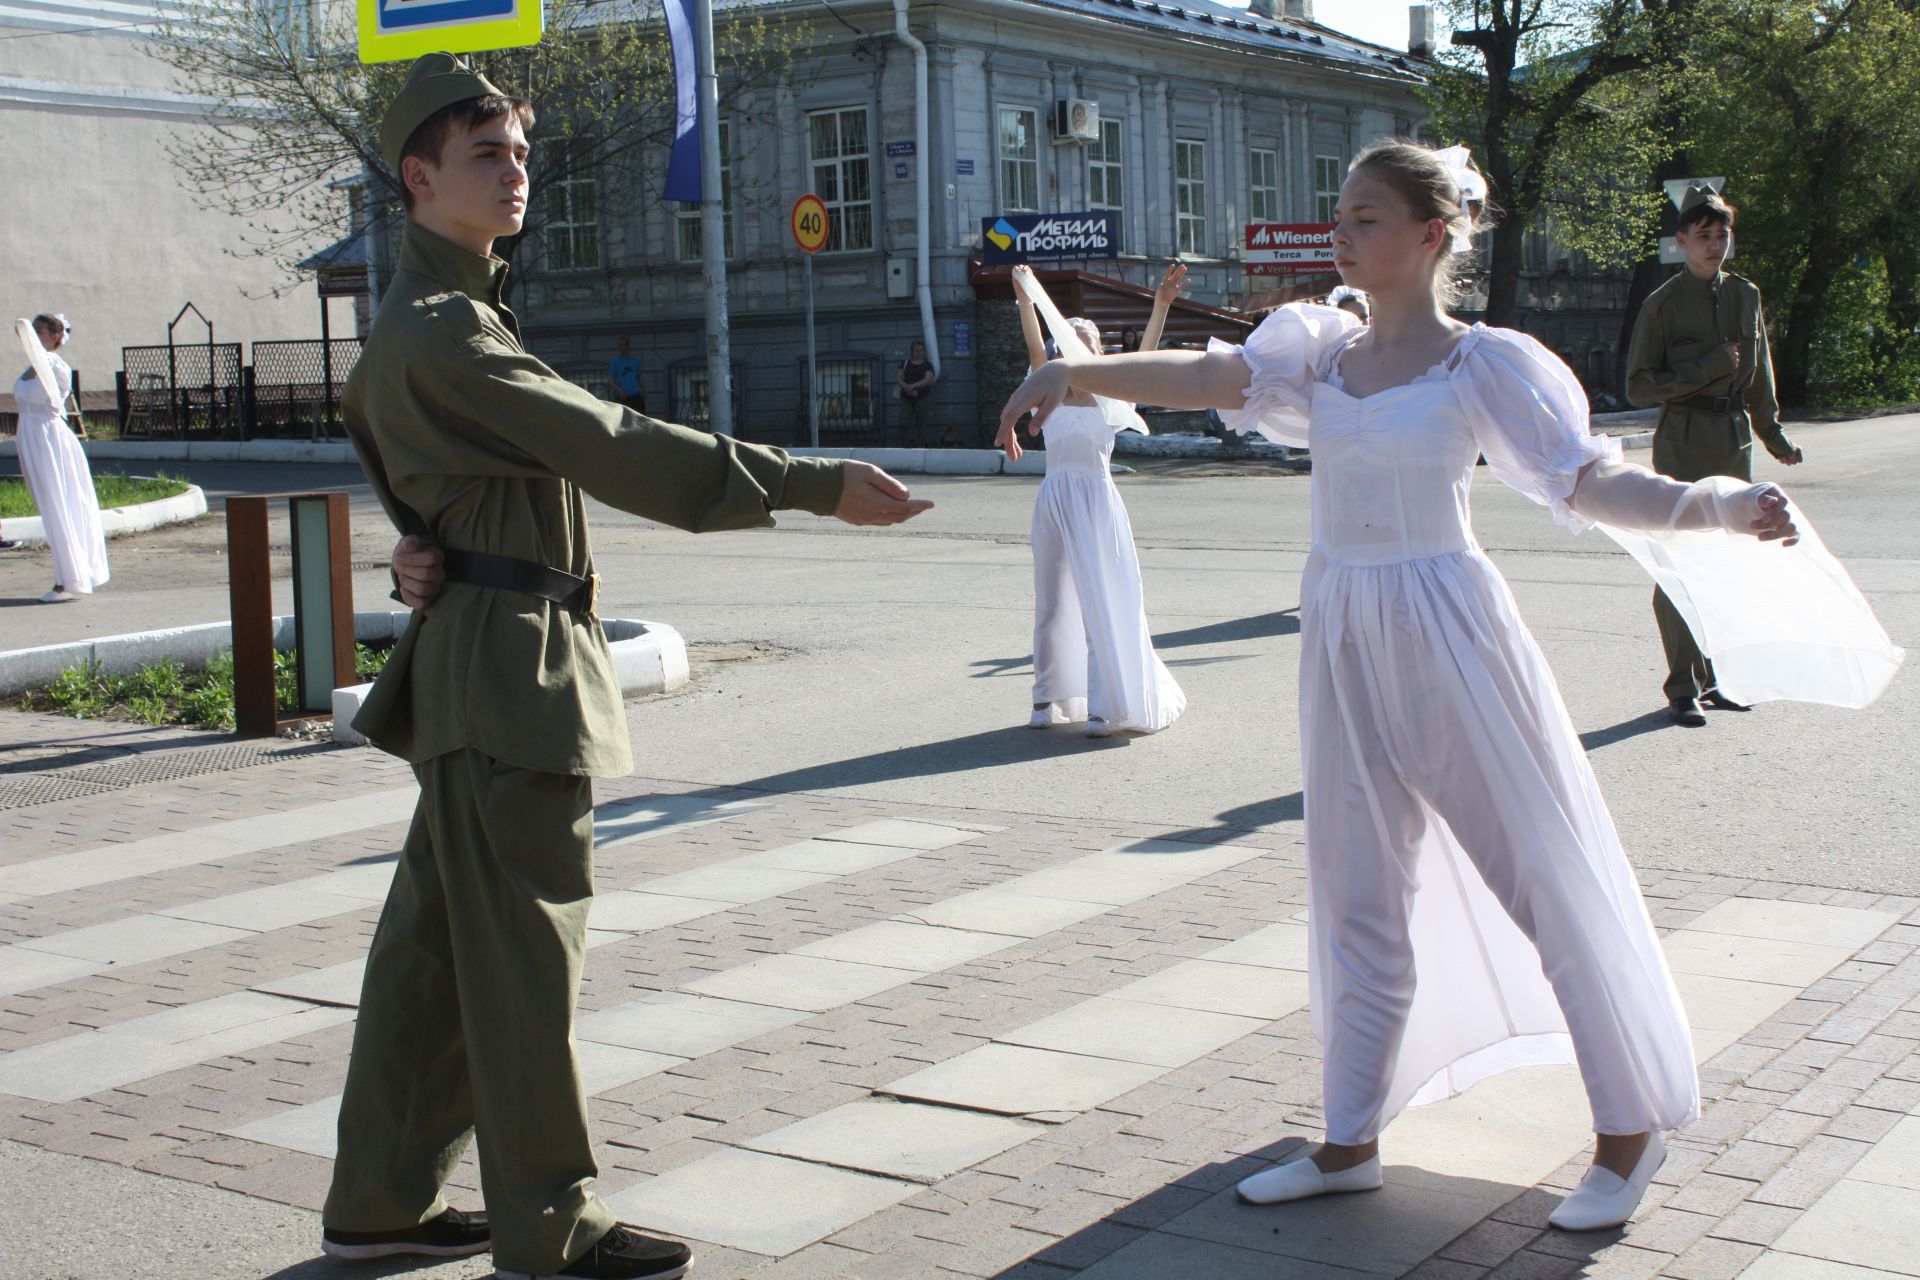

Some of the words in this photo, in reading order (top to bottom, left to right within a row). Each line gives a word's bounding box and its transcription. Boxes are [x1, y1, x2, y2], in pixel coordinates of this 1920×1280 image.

[800, 212, 820, 234] 40
[1031, 218, 1106, 237] МЕТАЛЛ
[1016, 231, 1108, 252] ПРОФИЛЬ
[1273, 250, 1301, 259] Terca
[1267, 265, 1292, 273] Venta
